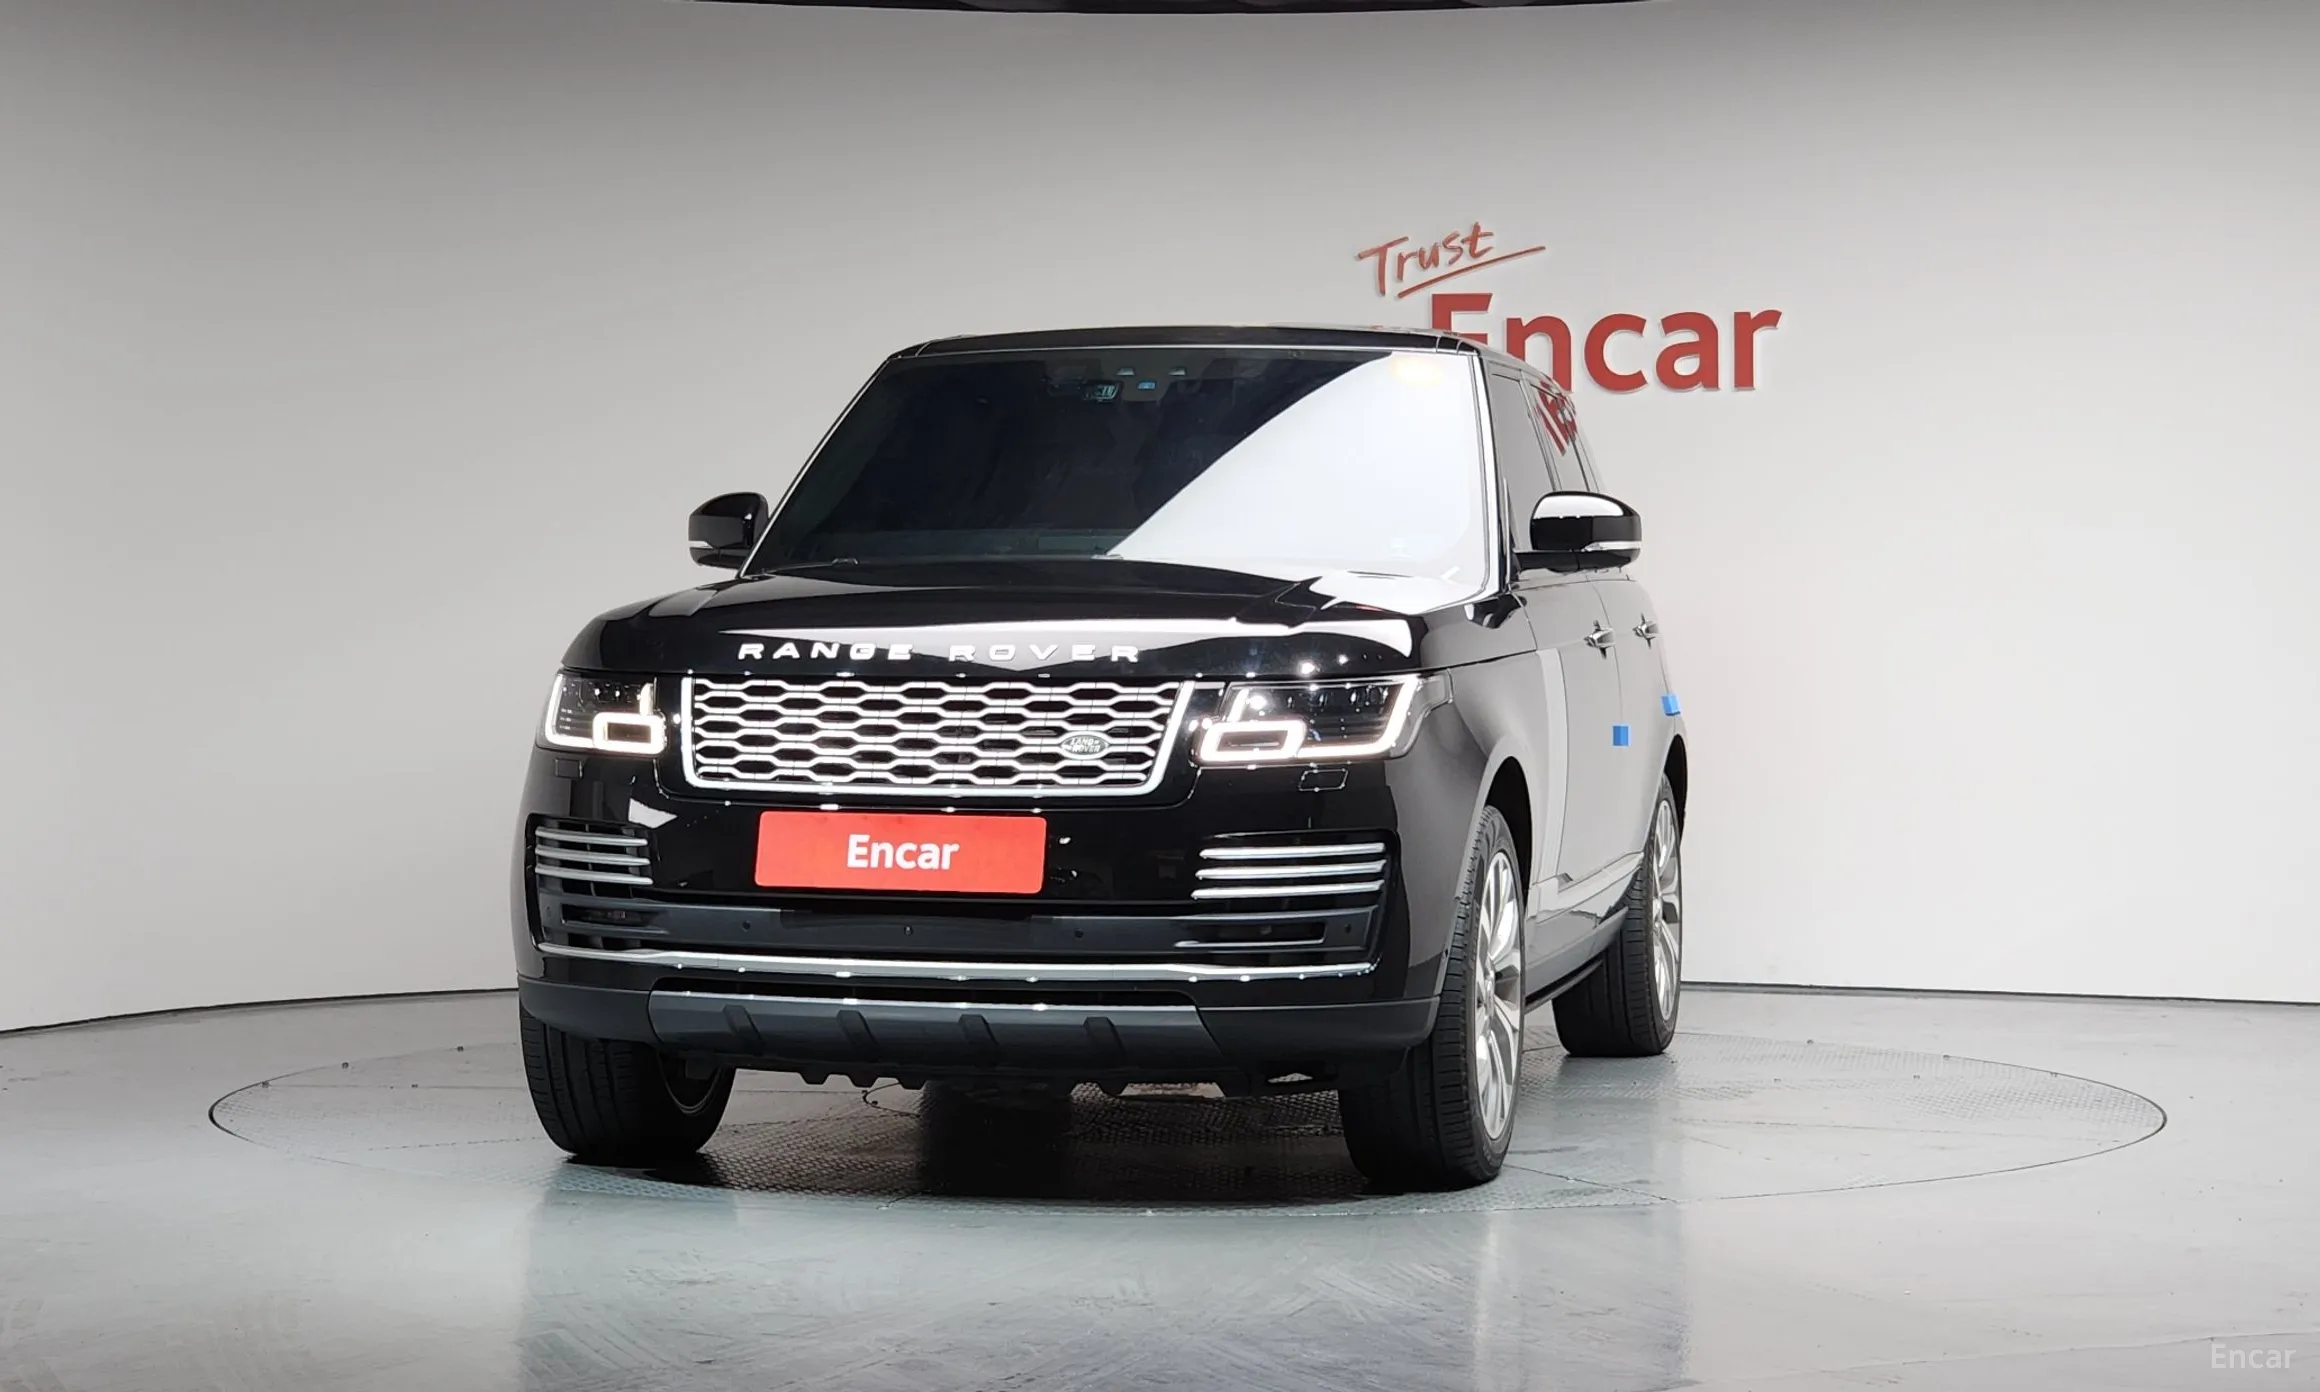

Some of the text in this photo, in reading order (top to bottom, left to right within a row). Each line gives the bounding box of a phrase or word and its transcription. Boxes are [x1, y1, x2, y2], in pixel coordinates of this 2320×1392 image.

[1357, 221, 1495, 297] Trust
[737, 641, 1140, 664] RANGE ROVER
[846, 834, 960, 870] Encar
